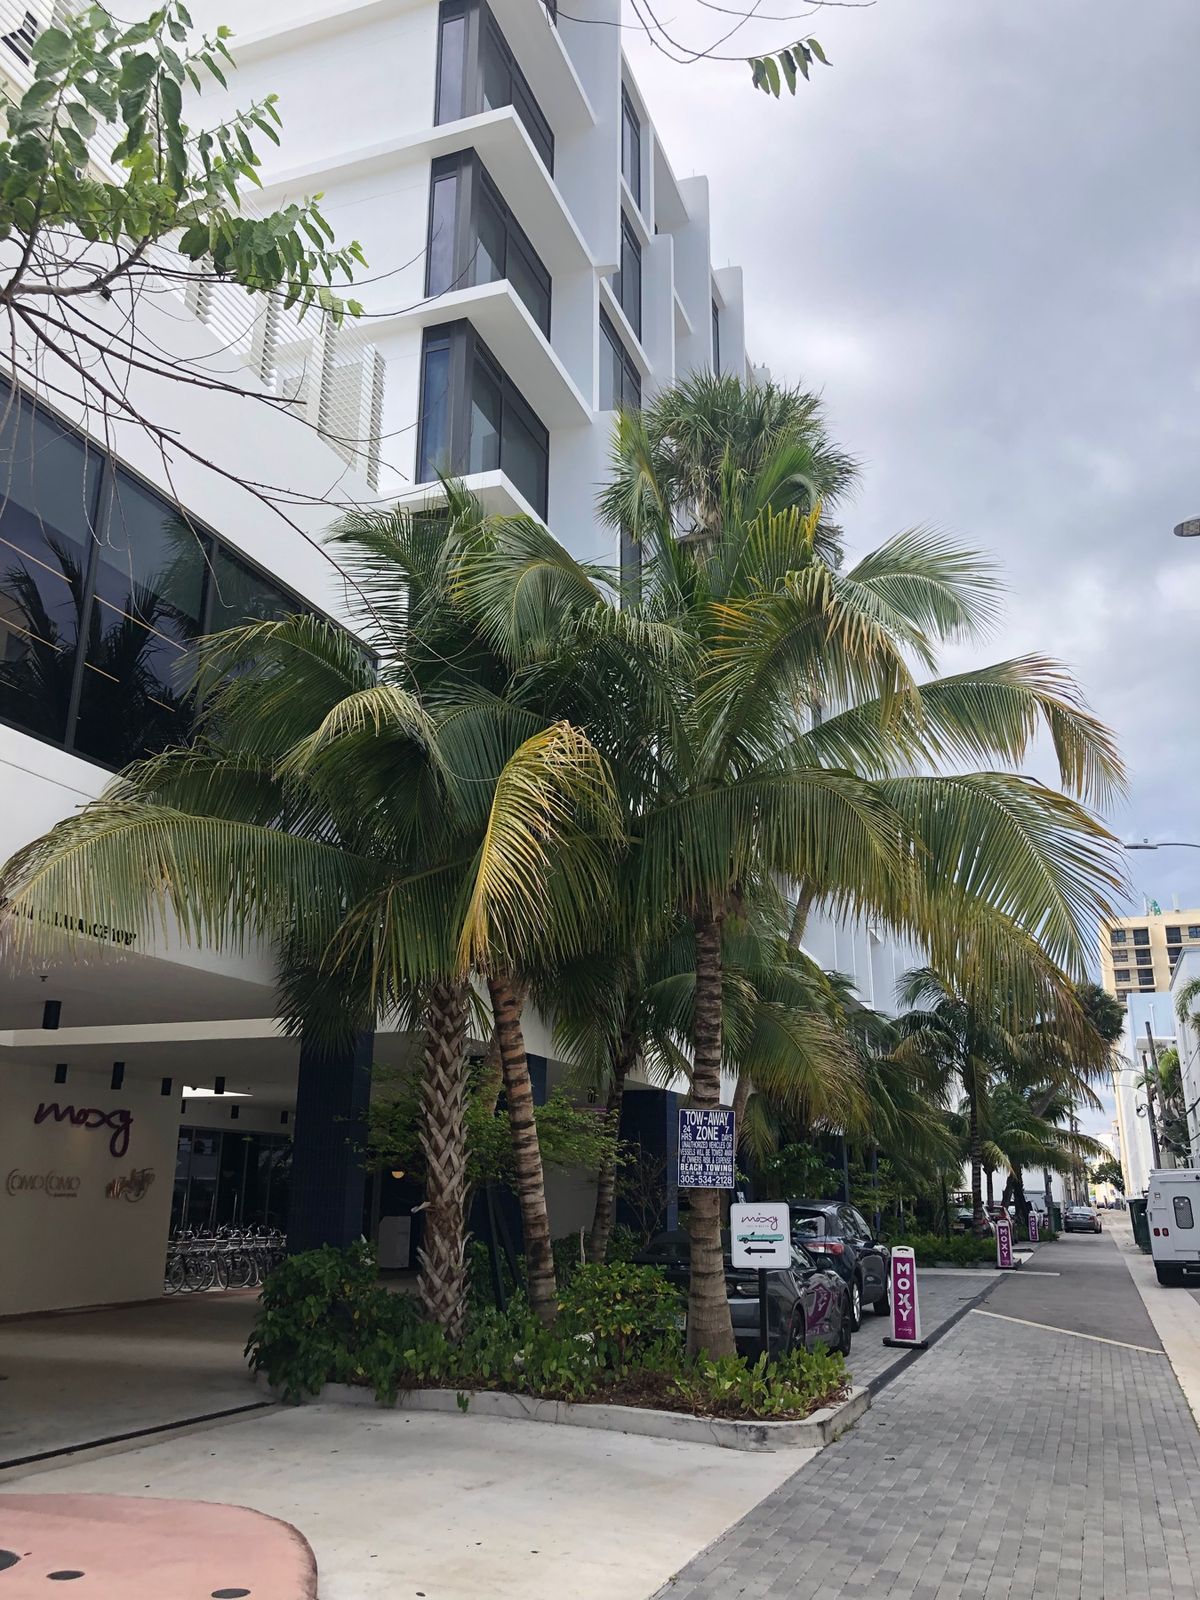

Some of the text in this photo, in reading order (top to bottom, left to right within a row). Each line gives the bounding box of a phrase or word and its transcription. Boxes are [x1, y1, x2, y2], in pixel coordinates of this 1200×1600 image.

[685, 1111, 729, 1126] TOW-AWAY
[682, 1125, 691, 1133] 24
[696, 1126, 719, 1140] ZONE
[725, 1126, 730, 1134] 7
[681, 1133, 692, 1141] HRS
[721, 1134, 732, 1142] DAYS
[709, 1141, 725, 1149] VEHICLES
[680, 1163, 733, 1172] BEACH TOWING
[680, 1175, 733, 1184] 305-534-2128
[1000, 1228, 1008, 1258] MOXY
[896, 1262, 912, 1321] MOXY
